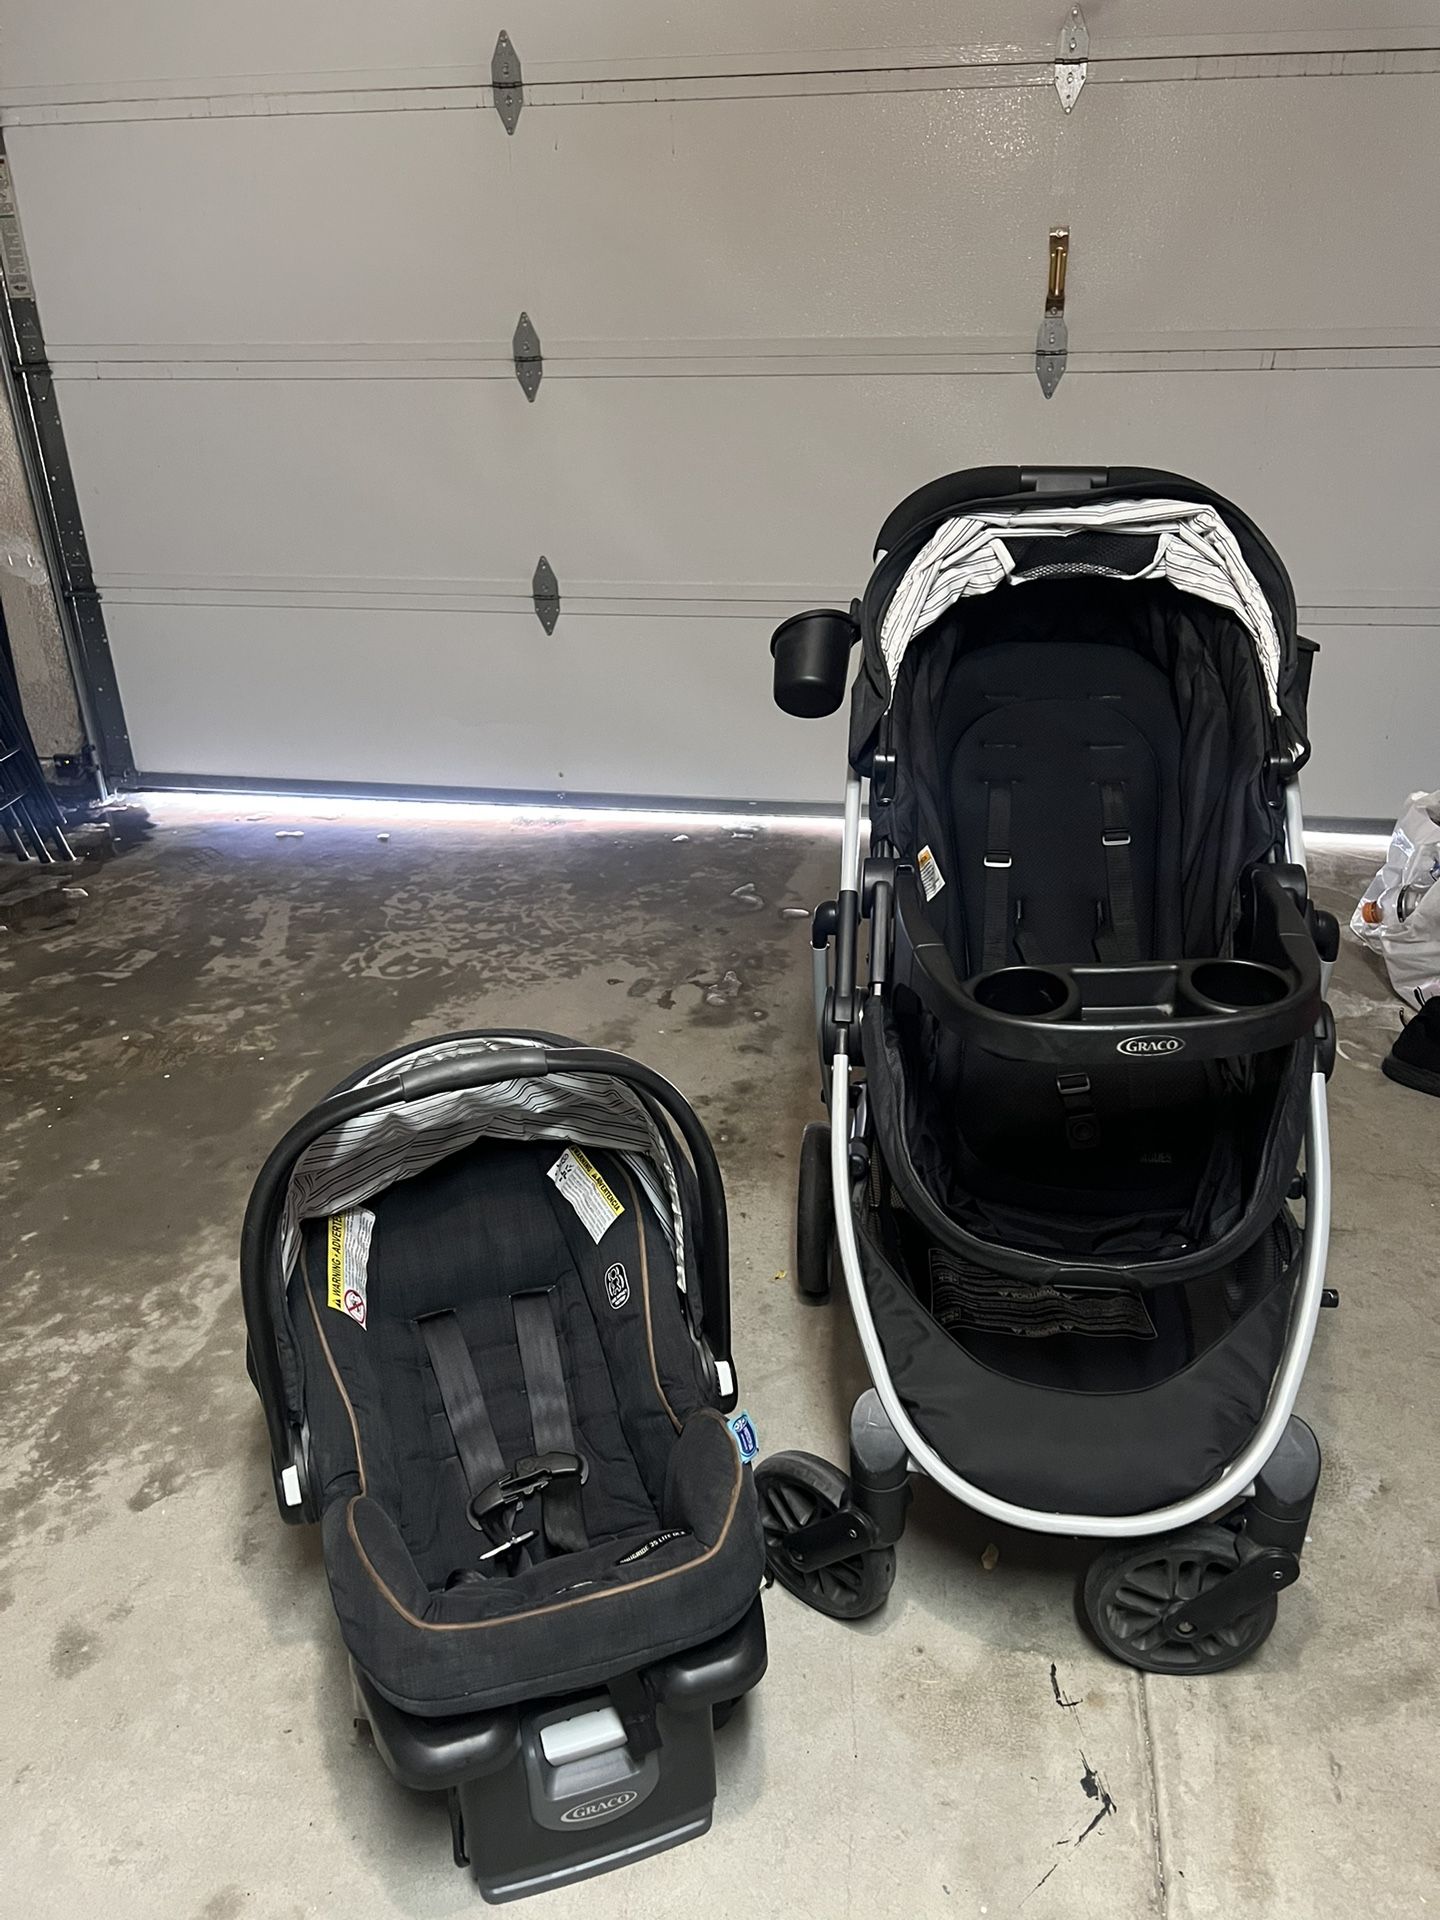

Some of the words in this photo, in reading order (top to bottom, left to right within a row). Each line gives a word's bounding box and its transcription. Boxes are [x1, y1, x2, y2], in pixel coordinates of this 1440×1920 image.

[1126, 1040, 1178, 1052] GRACO
[596, 1176, 620, 1211] ADVERTENCIA
[331, 1258, 342, 1296] WARNING
[573, 1794, 629, 1818] GRACO
